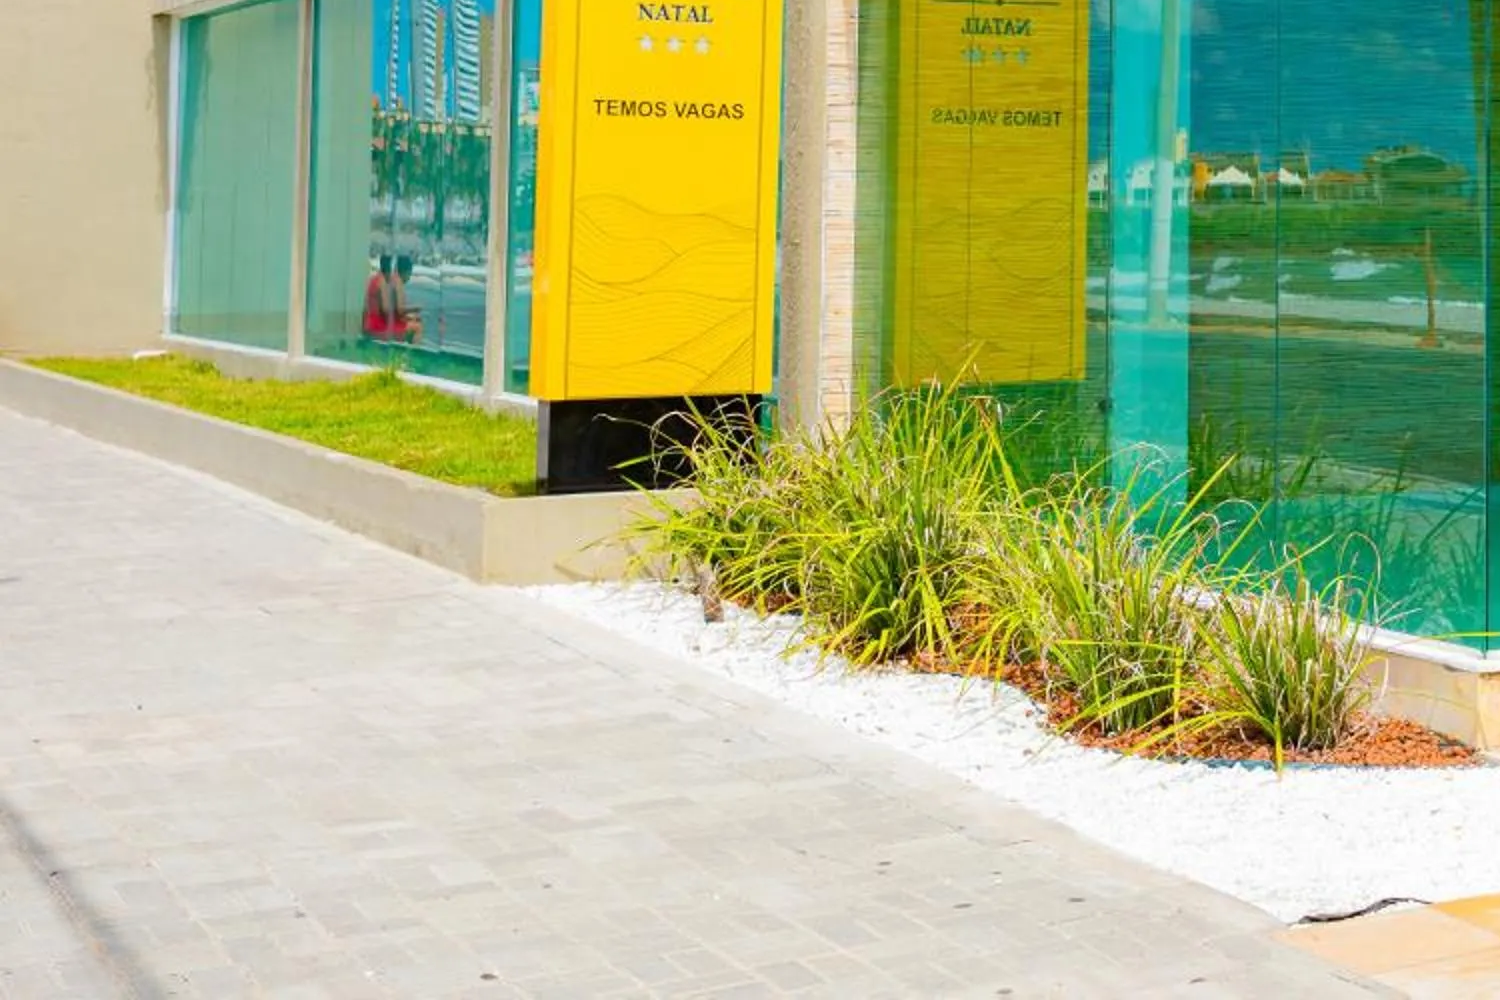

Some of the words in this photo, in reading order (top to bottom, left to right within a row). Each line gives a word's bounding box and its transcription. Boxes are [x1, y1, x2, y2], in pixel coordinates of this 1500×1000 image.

[637, 3, 714, 24] NATAL
[593, 99, 667, 118] TEMOS
[673, 102, 745, 120] VAGAS
